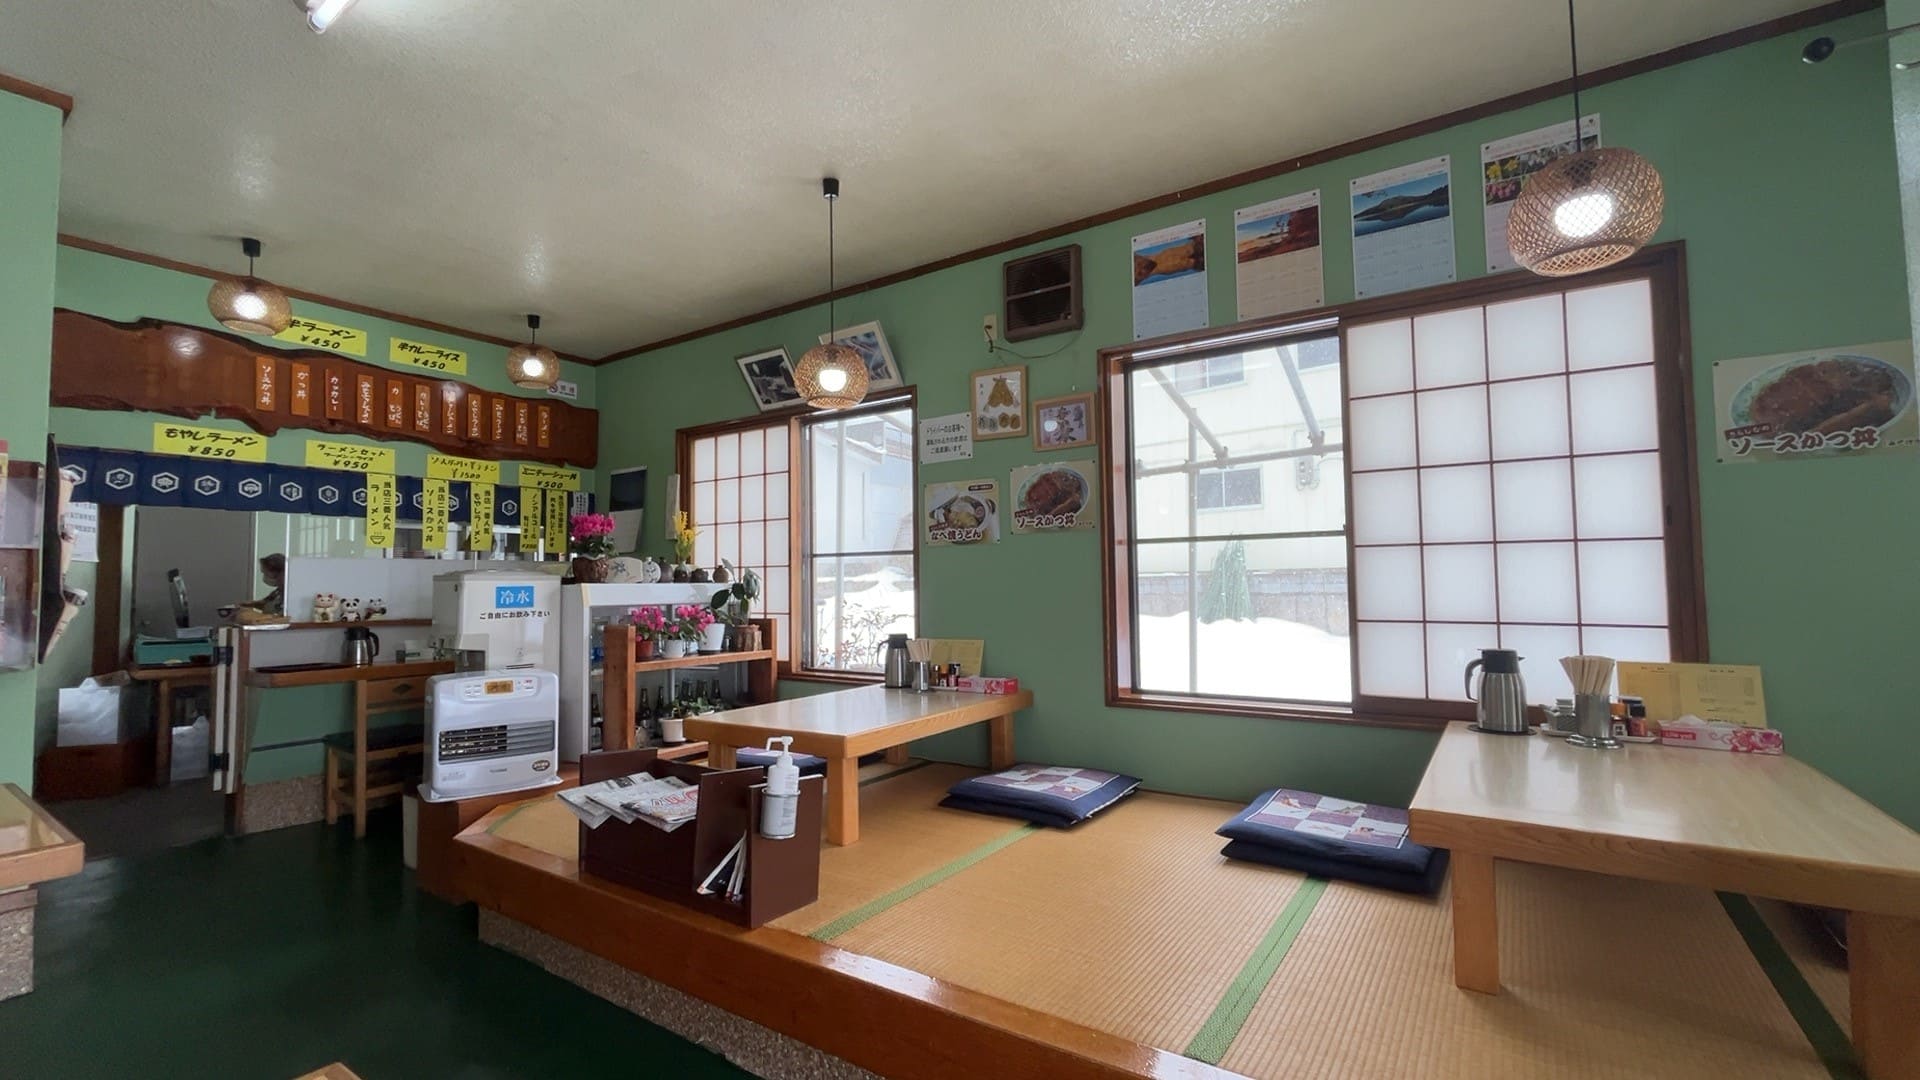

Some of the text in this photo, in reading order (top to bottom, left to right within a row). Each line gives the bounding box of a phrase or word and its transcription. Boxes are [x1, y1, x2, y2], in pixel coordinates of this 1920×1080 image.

[301, 335, 341, 349] ¥450
[412, 357, 446, 370] ¥450
[164, 428, 259, 447] もやしラーメン
[1731, 428, 1878, 455] ソースかつ丼
[187, 445, 236, 458] ¥850
[317, 444, 385, 457] ラーメンセット
[333, 459, 369, 469] ¥950
[537, 480, 563, 489] ¥500
[370, 484, 380, 526] ラーメン
[425, 488, 434, 543] ソースかつ丼
[473, 492, 481, 545] もやしラーメン
[500, 590, 530, 605] 冷水
[479, 611, 551, 620] ご自由にお飲み下さい
